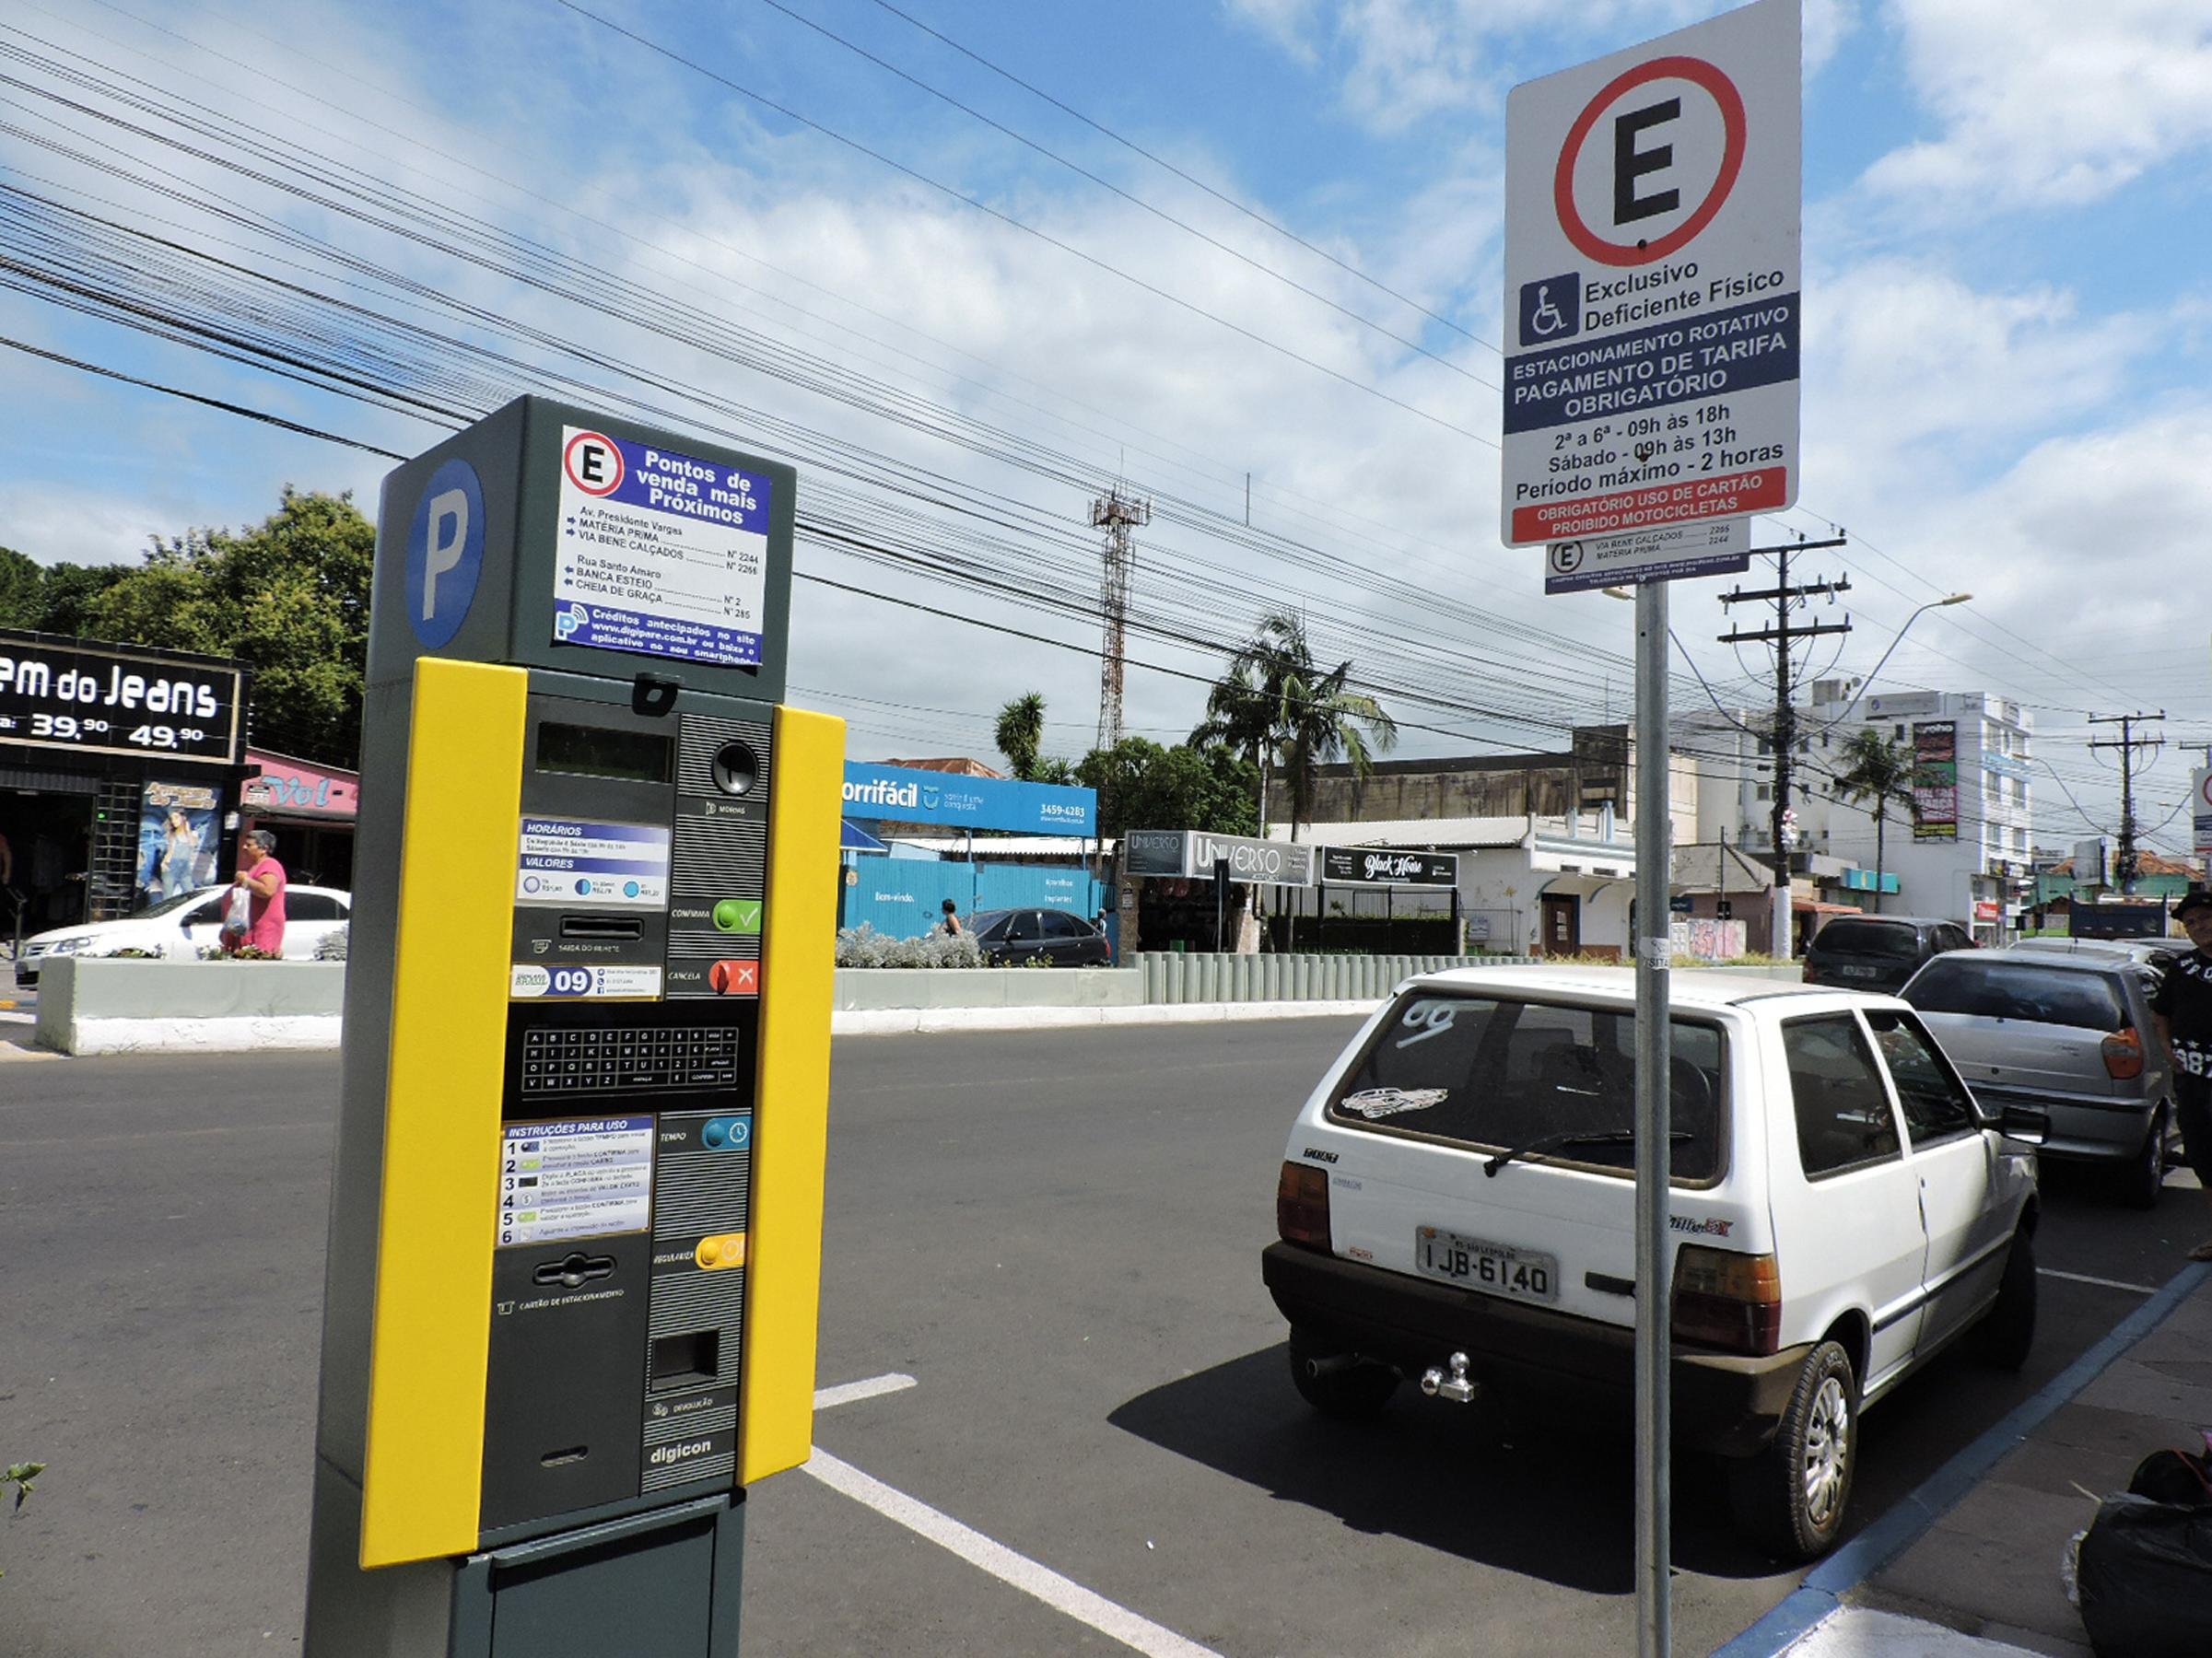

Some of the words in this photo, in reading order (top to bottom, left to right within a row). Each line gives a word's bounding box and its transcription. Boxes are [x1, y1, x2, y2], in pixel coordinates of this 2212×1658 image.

[1614, 97, 1680, 226] E
[1586, 262, 1699, 303] Exclusivo
[1586, 290, 1701, 332] Deficiente
[1710, 271, 1785, 302] Físico
[1514, 332, 1683, 380] ESTACIONAMENTO
[1689, 306, 1789, 343] ROTATIVO
[1515, 361, 1655, 404] PAGAMENTO
[1661, 353, 1693, 376] DE
[1700, 333, 1786, 367] TARIFA
[1566, 369, 1727, 416] OBRIGATÓRIO
[1577, 433, 1587, 447] a
[1628, 416, 1660, 438] 09h
[1667, 413, 1689, 430] às
[1695, 404, 1730, 425] 18h
[582, 445, 604, 484] E
[1549, 450, 1617, 473] Sábado
[1634, 438, 1668, 462] 09h
[1673, 436, 1695, 453] às
[1703, 427, 1737, 447] 13h
[645, 450, 716, 483] Pontos
[727, 473, 751, 492] de
[1516, 475, 1592, 500] Período
[1598, 461, 1680, 488] máximo
[1701, 453, 1713, 472] 2
[1720, 443, 1784, 466] horas
[637, 470, 698, 496] venda
[710, 486, 756, 510] mais
[650, 487, 743, 524] Próximos
[1538, 496, 1633, 521] OBRIGATÓRIO
[1638, 485, 1668, 506] USO
[1673, 485, 1693, 501] DE
[1696, 475, 1762, 498] CARTÃO
[579, 518, 626, 534] MATÉRIA
[627, 529, 659, 543] PRIMA
[580, 507, 594, 518] Av.
[599, 510, 649, 529] Presidente
[651, 521, 683, 536] Vargas
[1552, 515, 1620, 535] PROIBIDO
[1621, 496, 1738, 525] MOTOCICLETAS
[423, 488, 469, 621] P
[579, 530, 597, 543] VIA
[599, 534, 626, 548] BENE
[628, 540, 684, 560] CALÇADOS
[1561, 544, 1574, 566] E
[576, 566, 613, 582] BANCA
[616, 575, 652, 590] ESTEIO
[578, 555, 597, 566] Rua
[599, 559, 628, 572] Santo
[630, 565, 661, 578] Amaro
[576, 579, 607, 593] CHEIA
[610, 587, 624, 597] DE
[627, 589, 662, 604] GRAÇA
[591, 634, 644, 648] aplicativo
[650, 643, 663, 651] no
[592, 608, 640, 625] Créditos
[647, 620, 711, 637] antecipados
[718, 632, 730, 640] no
[736, 634, 755, 645] site
[57, 669, 96, 704] do
[103, 665, 217, 718] Jeans
[527, 823, 582, 835] HORÁRIOS
[525, 857, 574, 869] VALORES
[555, 971, 588, 991] 09
[509, 1126, 576, 1138] INSTRUÇÕES
[578, 1122, 603, 1132] PARA
[606, 1120, 627, 1130] USO
[508, 1142, 515, 1154] 1
[507, 1160, 516, 1172] 2
[505, 1177, 514, 1190] 3
[503, 1195, 514, 1208] 4
[503, 1212, 513, 1225] 5
[502, 1231, 512, 1244] 6
[1426, 1244, 1547, 1294] IJB-6140
[650, 1441, 711, 1464] digicon
